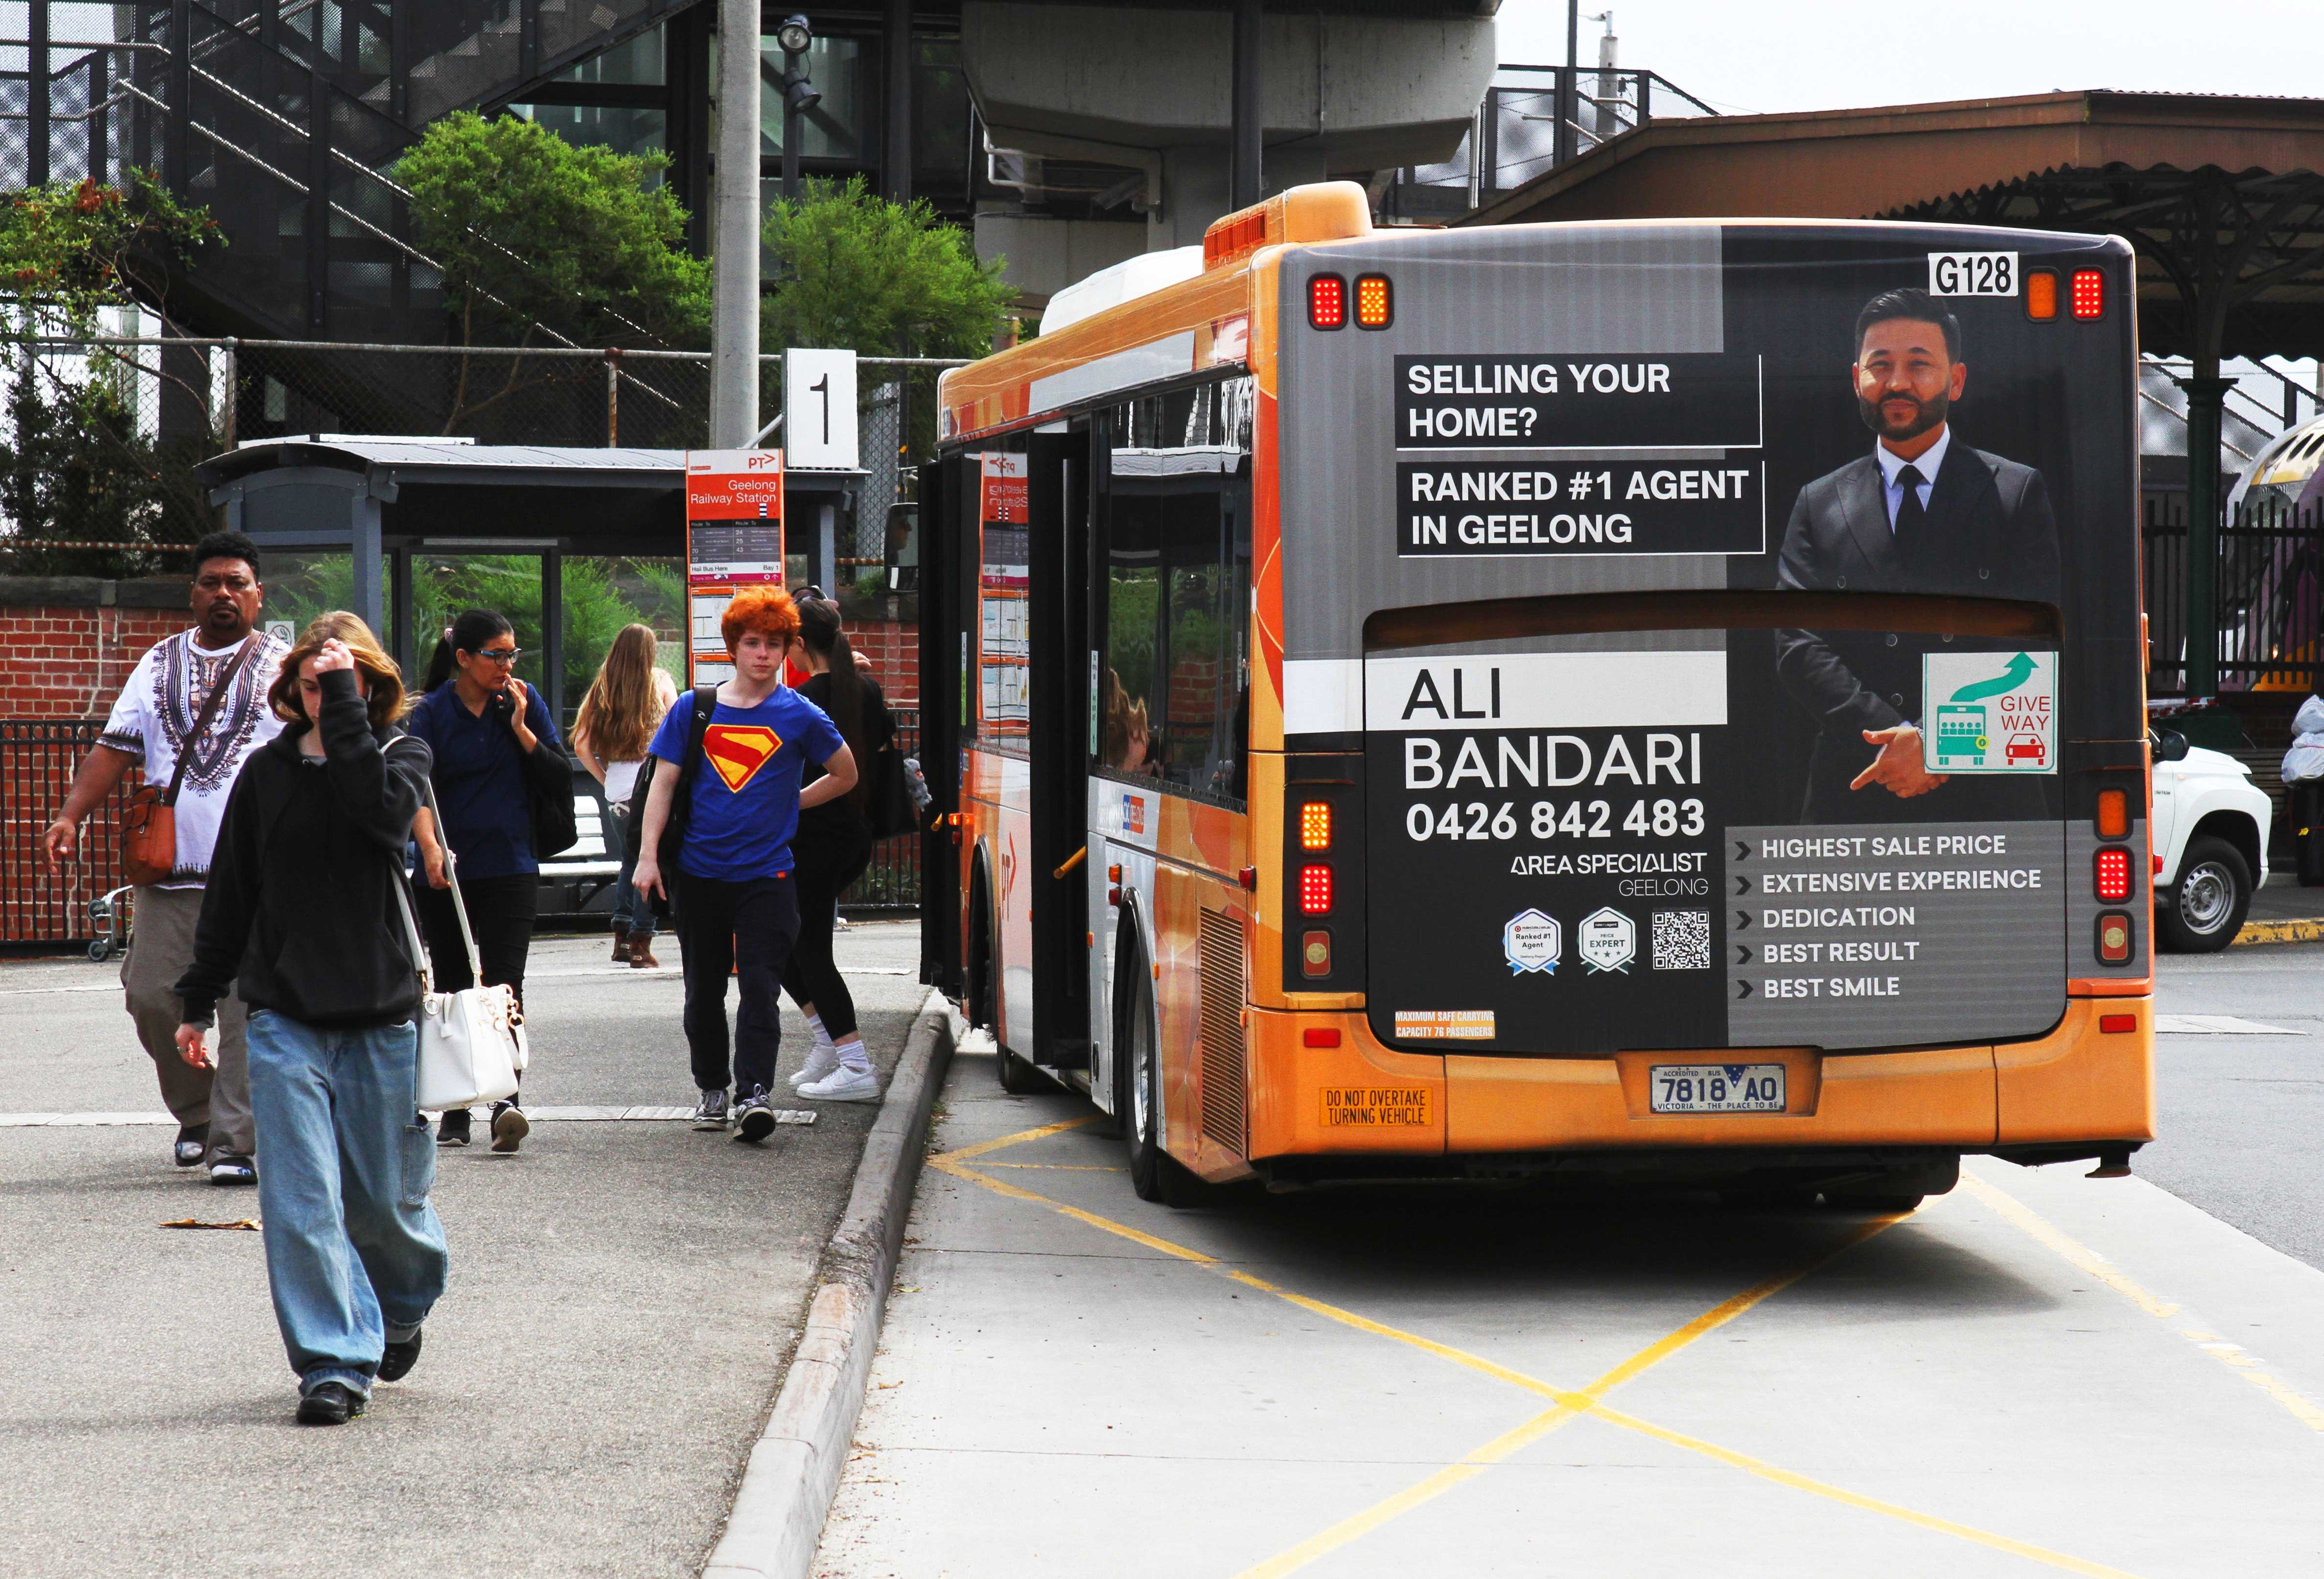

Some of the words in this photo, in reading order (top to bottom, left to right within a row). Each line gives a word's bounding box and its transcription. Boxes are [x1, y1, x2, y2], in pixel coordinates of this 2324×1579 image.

[1936, 256, 2011, 294] G128
[1408, 364, 1558, 394] SELLING
[1568, 364, 1670, 393] YOUR
[810, 373, 828, 445] 1
[1409, 407, 1537, 437] HOME?
[728, 480, 776, 492] Geelong
[1412, 472, 1557, 501] RANKED
[1569, 471, 1611, 500] #1
[1626, 470, 1749, 500] AGENT
[691, 494, 732, 505] Railway
[736, 493, 776, 503] Station
[1412, 516, 1446, 544] IN
[1458, 514, 1632, 544] GEELONG
[1401, 668, 1500, 720] ALI
[2000, 696, 2050, 711] GIVE
[2001, 715, 2049, 731] WAY
[1405, 733, 1700, 789] BANDARI
[1406, 802, 1517, 841] 0426
[1530, 800, 1611, 839] 842
[1623, 798, 1705, 836] 483
[1763, 838, 1865, 858] HIGHEST
[1872, 836, 1930, 857] SALE
[1937, 835, 2006, 855] PRICE
[1511, 855, 1574, 875] AREA
[1577, 852, 1707, 874] SPECIALIST
[1619, 878, 1708, 896] GEELONG
[1763, 872, 1891, 893] EXTENSIVE
[1898, 869, 2041, 890] EXPERIENCE
[1763, 907, 1915, 928] DEDICATION
[1764, 943, 1823, 963] BEST
[1830, 942, 1920, 962] RESULT
[1765, 978, 1824, 998] BEST
[1830, 977, 1900, 997] SMILE
[1395, 1011, 1435, 1022] MAXIMUM
[1438, 1011, 1455, 1022] SAFE
[1457, 1010, 1494, 1022] CARRYING
[1396, 1026, 1432, 1037] CAPACITY
[1434, 1026, 1444, 1037] 76
[1446, 1026, 1492, 1037] PASSENGERS
[1327, 1090, 1340, 1106] DO
[1345, 1090, 1366, 1106] NOT
[1370, 1090, 1425, 1106] OVERTAKE
[1659, 1078, 1726, 1102] 7818
[1328, 1108, 1375, 1124] TURNING
[1379, 1108, 1424, 1124] VEHICLE
